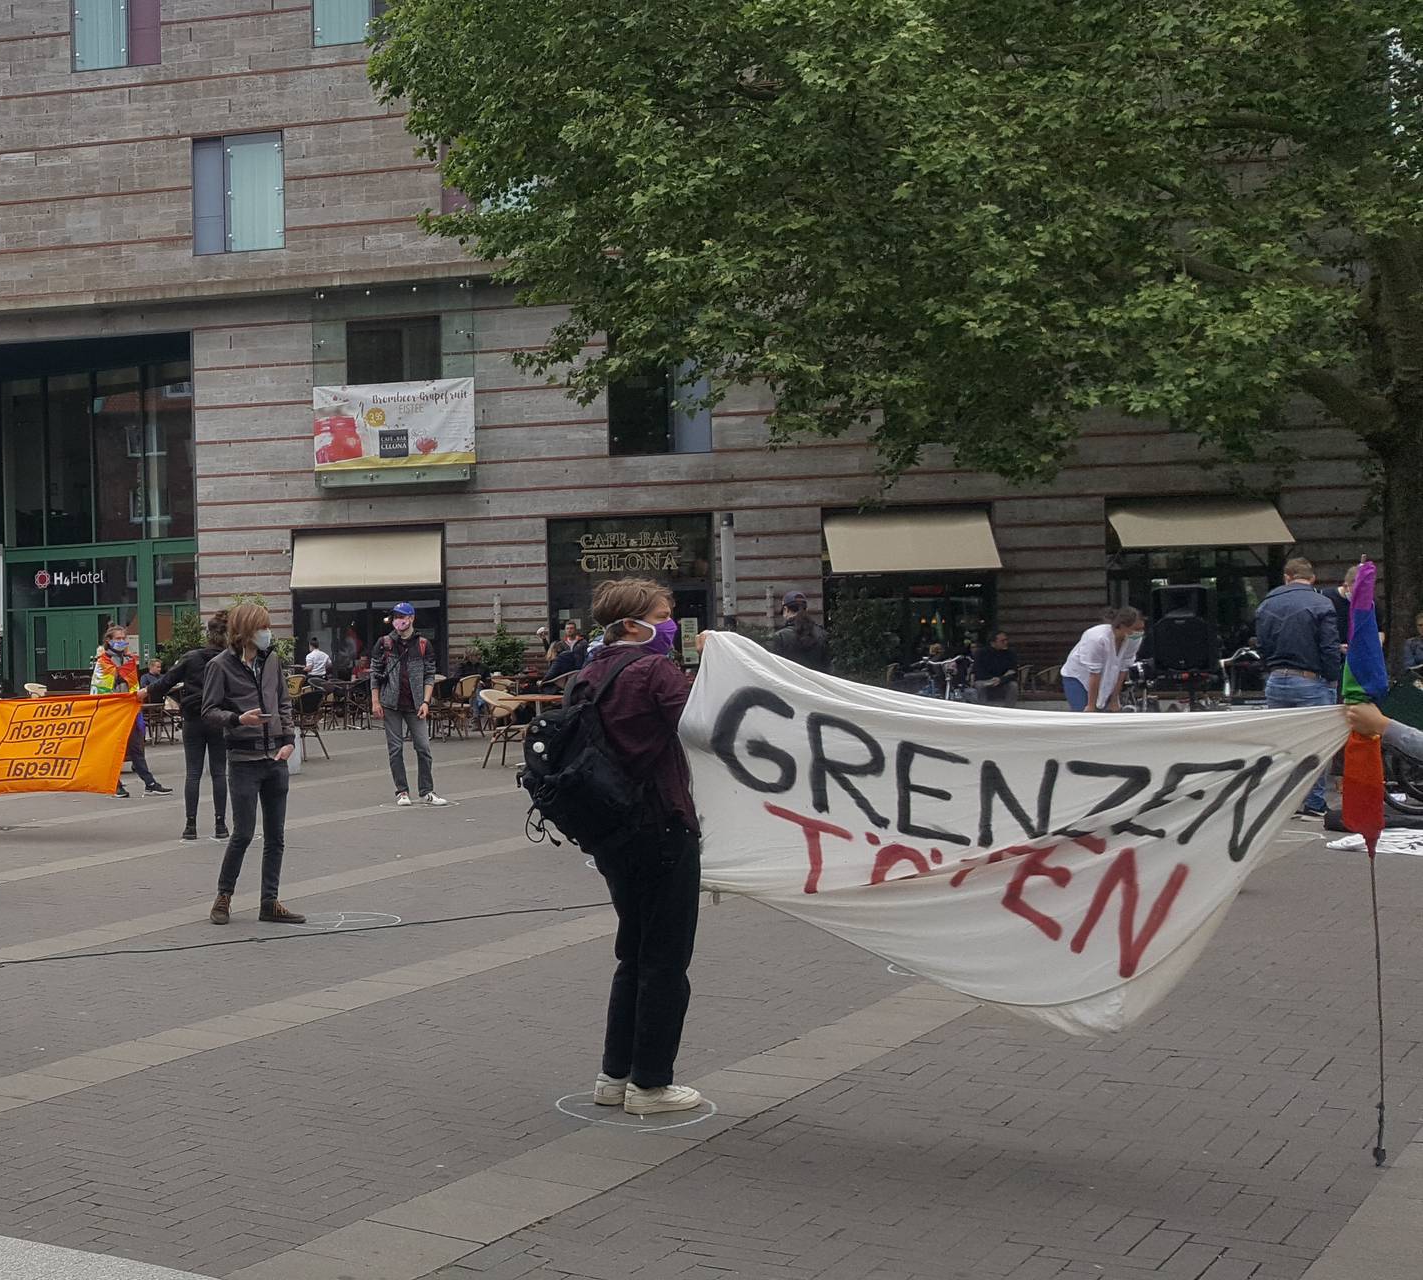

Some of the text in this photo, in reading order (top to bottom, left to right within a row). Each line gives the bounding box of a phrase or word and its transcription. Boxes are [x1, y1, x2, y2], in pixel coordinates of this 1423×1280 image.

[398, 403, 425, 414] EISTEE
[640, 530, 678, 546] BAR
[580, 552, 678, 573] CELONA
[711, 685, 1322, 862] GRENZEN
